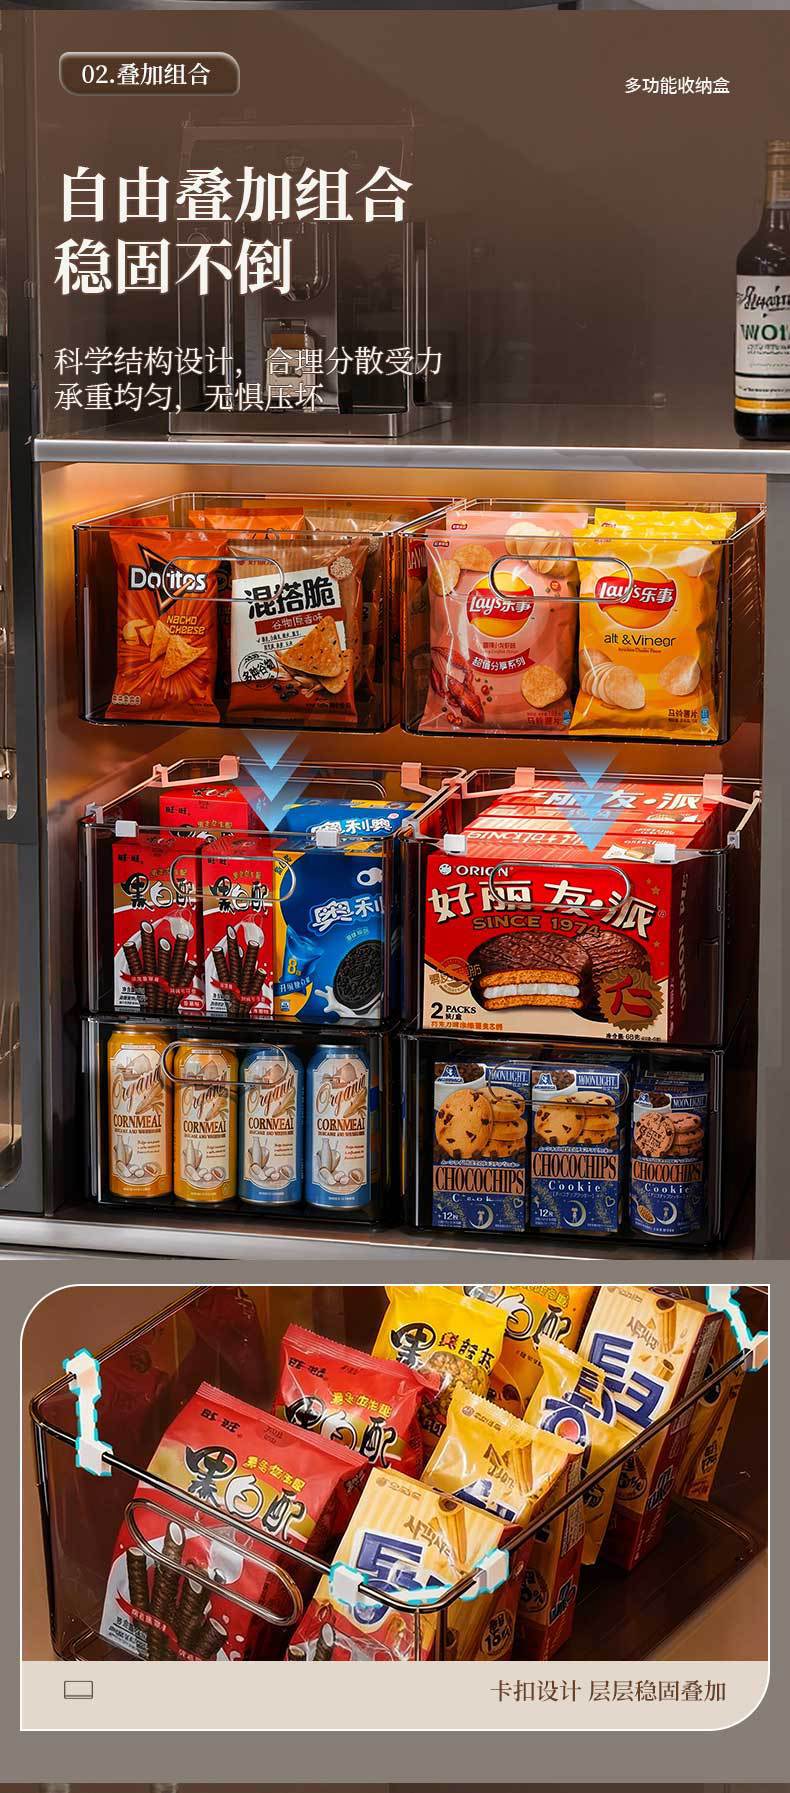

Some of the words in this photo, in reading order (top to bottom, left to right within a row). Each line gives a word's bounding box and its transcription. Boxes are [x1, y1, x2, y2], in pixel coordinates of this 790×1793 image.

[130, 567, 207, 592] Doritos
[244, 576, 336, 620] 混搭脆
[604, 633, 619, 644] alt
[456, 865, 510, 877] ORION
[472, 915, 541, 930] SINCE
[551, 917, 602, 937] 1974
[430, 1001, 444, 1019] 2
[445, 1004, 477, 1014] PACKS
[533, 1152, 617, 1180] CHOCOCHIPS
[435, 1166, 524, 1195] CHOCOCHIPS
[548, 1180, 601, 1193] Cookie
